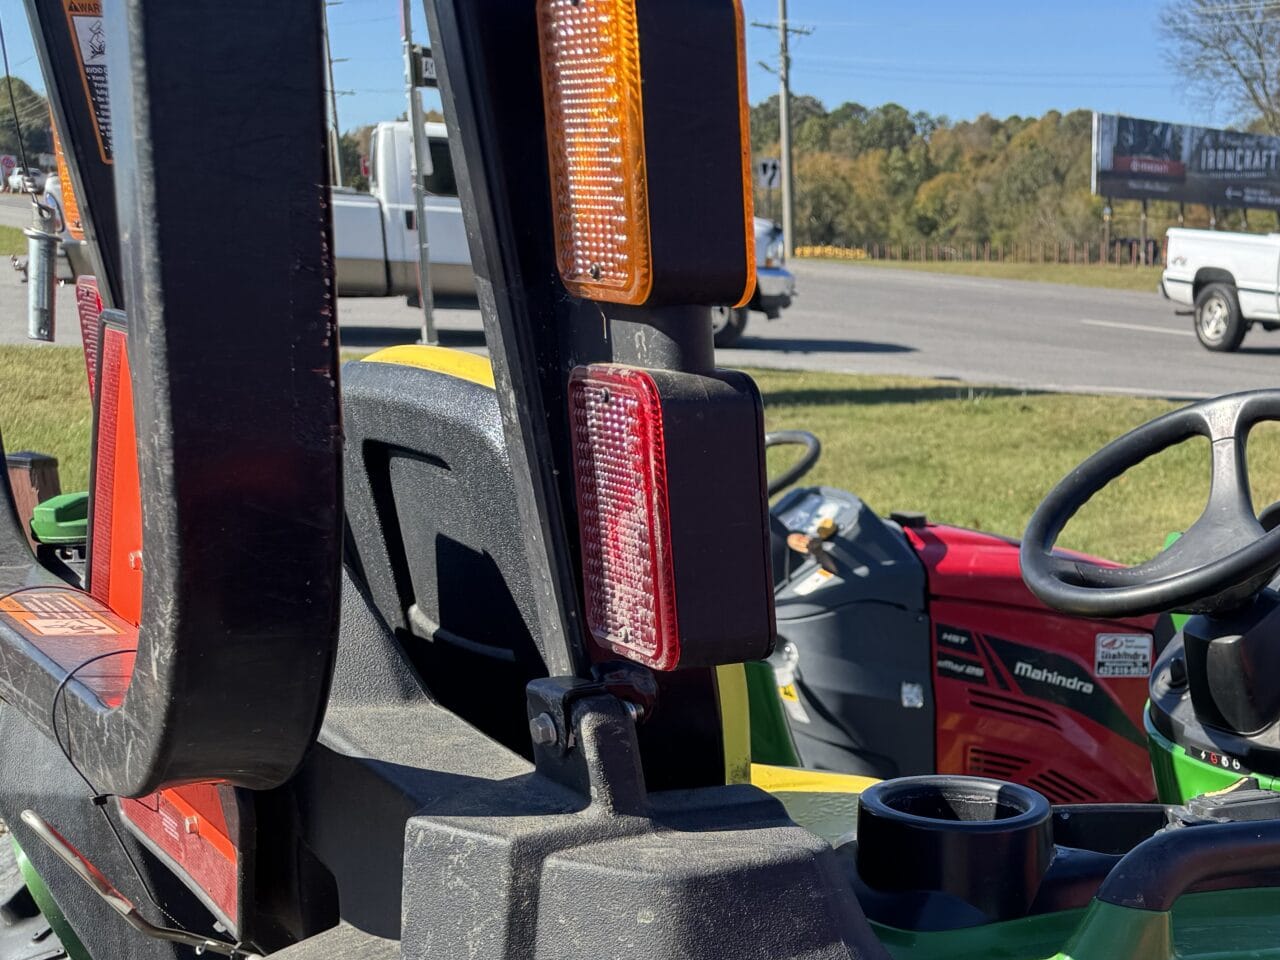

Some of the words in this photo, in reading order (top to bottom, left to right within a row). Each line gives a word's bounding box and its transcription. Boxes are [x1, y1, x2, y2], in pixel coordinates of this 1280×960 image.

[1201, 149, 1278, 171] IRONCRAFT
[941, 631, 968, 645] HST
[1014, 660, 1094, 695] Mahindra
